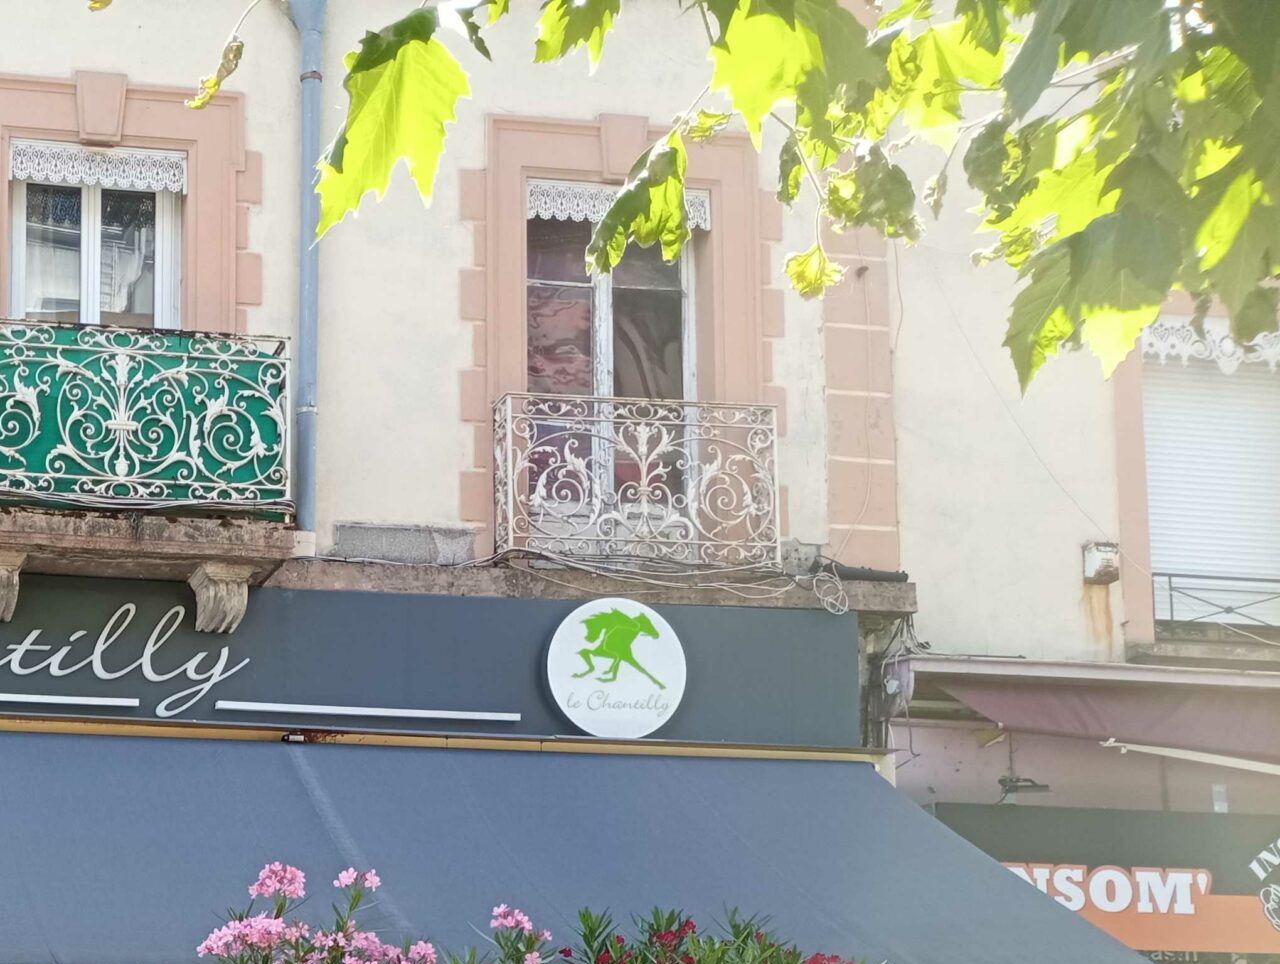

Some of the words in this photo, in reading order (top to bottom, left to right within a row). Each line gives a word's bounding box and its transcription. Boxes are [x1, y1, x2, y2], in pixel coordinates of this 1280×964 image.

[566, 691, 583, 709] le
[586, 689, 670, 718] Chantilly
[1248, 838, 1280, 881] IN
